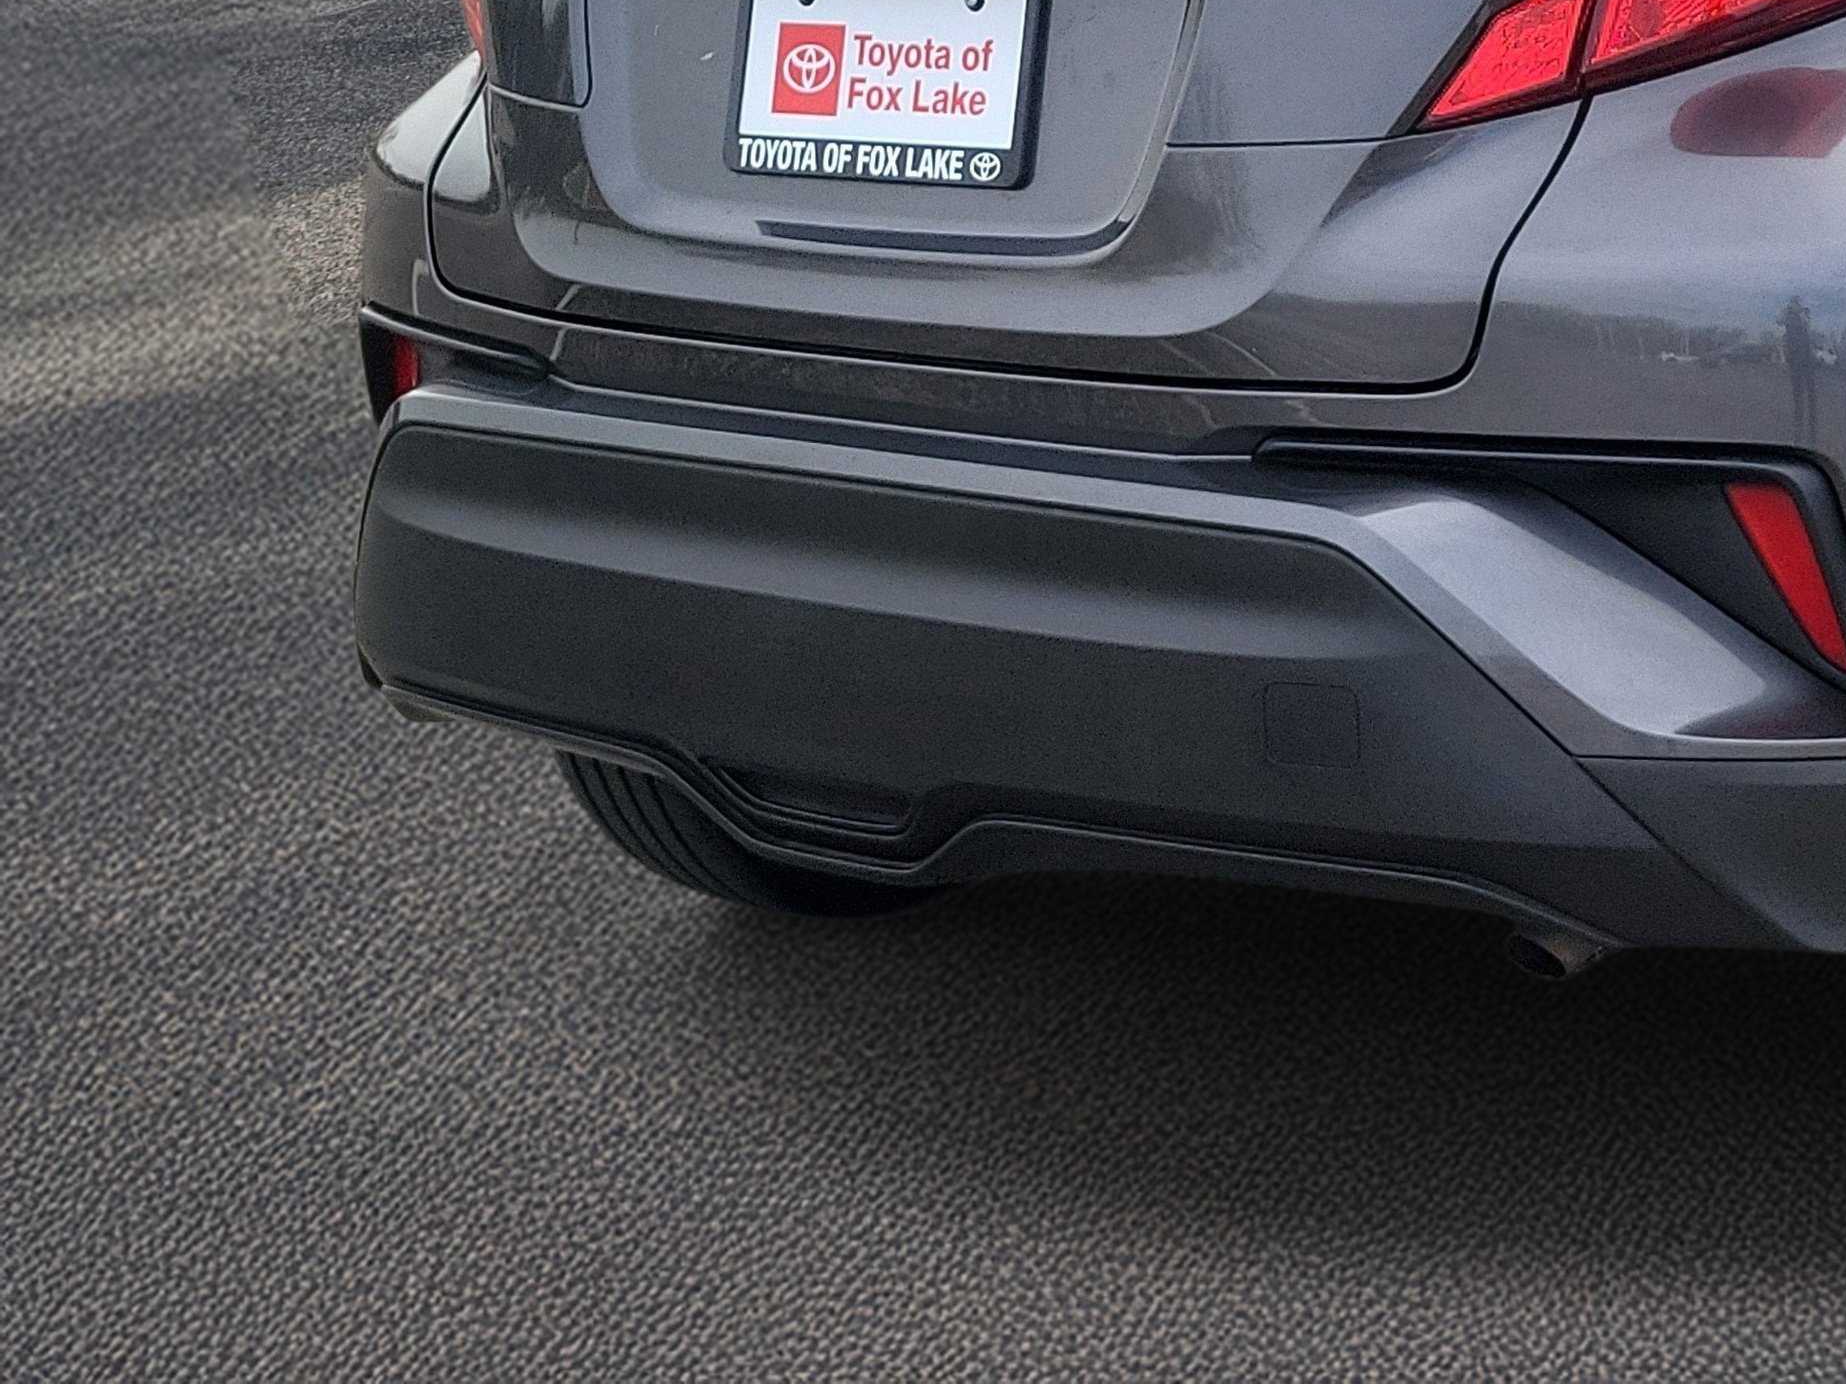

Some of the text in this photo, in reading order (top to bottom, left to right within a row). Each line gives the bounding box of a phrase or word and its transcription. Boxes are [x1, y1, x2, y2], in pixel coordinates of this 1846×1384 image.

[854, 34, 994, 76] Toyota of
[847, 77, 987, 116] Fox Lake
[738, 137, 965, 180] TOYOTA OF FOX LAKE
